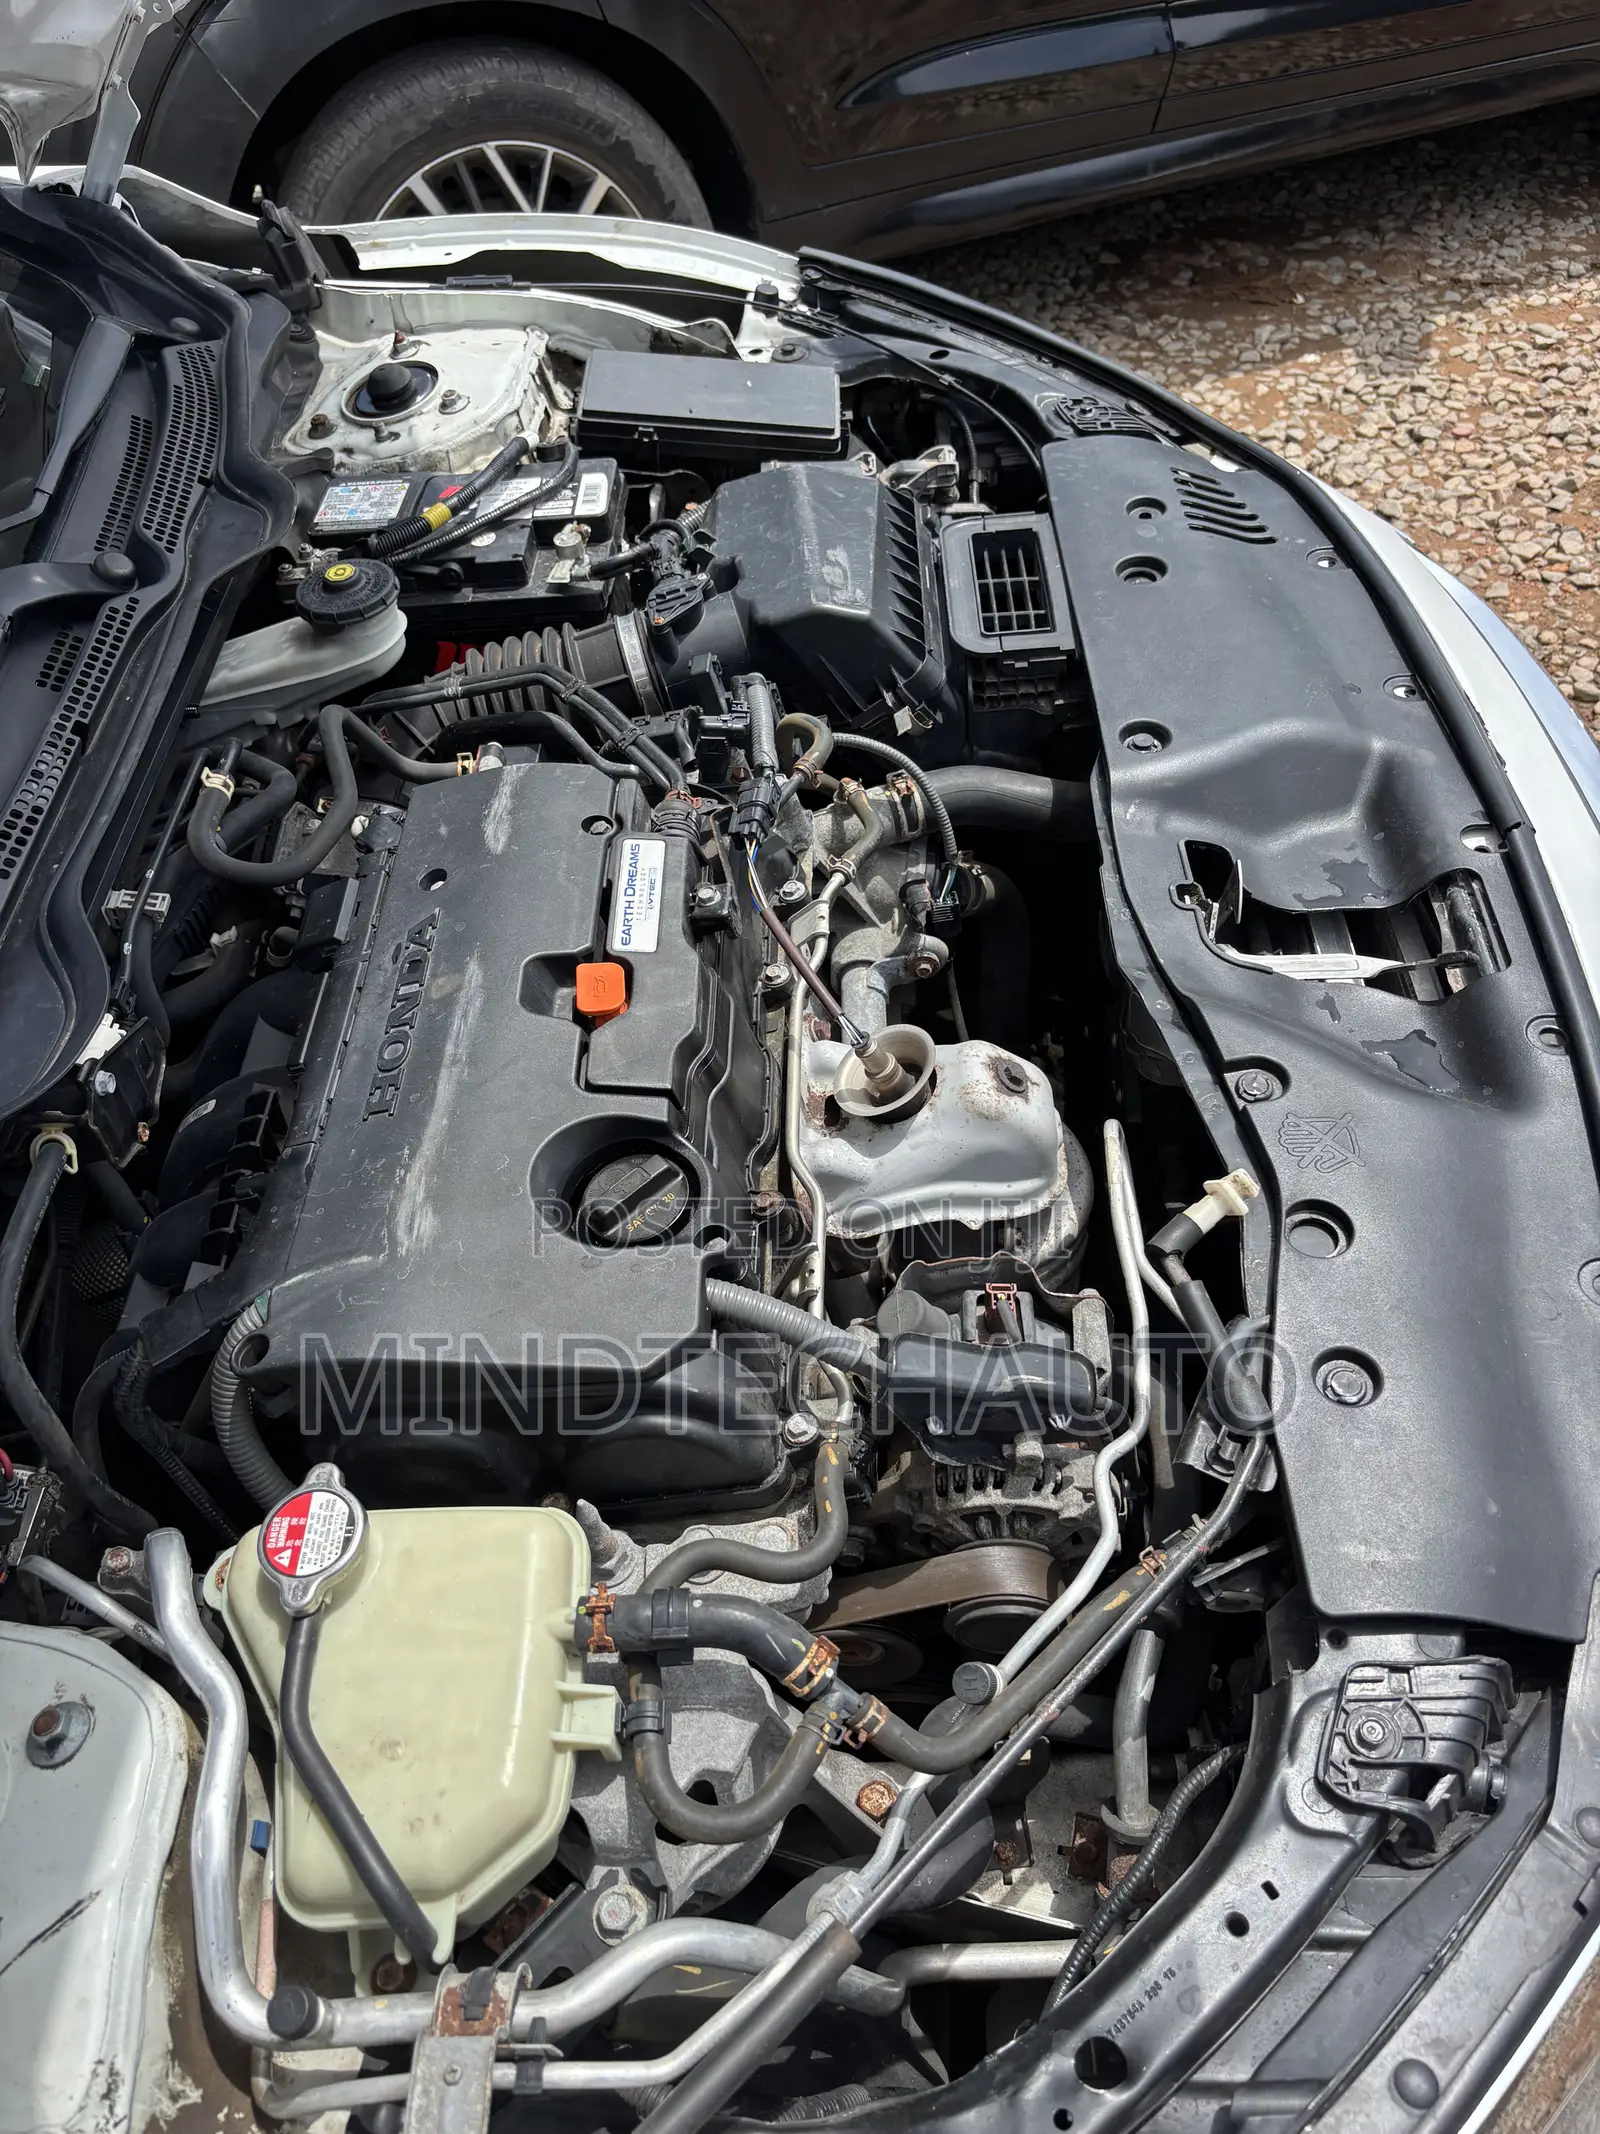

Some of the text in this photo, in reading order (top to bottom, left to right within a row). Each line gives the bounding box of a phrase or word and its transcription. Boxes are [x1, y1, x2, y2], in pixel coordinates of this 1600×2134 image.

[621, 843, 640, 946] EARTH DREAMS
[636, 867, 647, 921] TECHNOLOGY
[362, 907, 442, 1123] HONDA
[626, 1214, 645, 1232] SAE
[267, 1517, 282, 1549] DANGER
[276, 1516, 291, 1548] WARNUNG
[344, 1526, 354, 1537] 1.1
